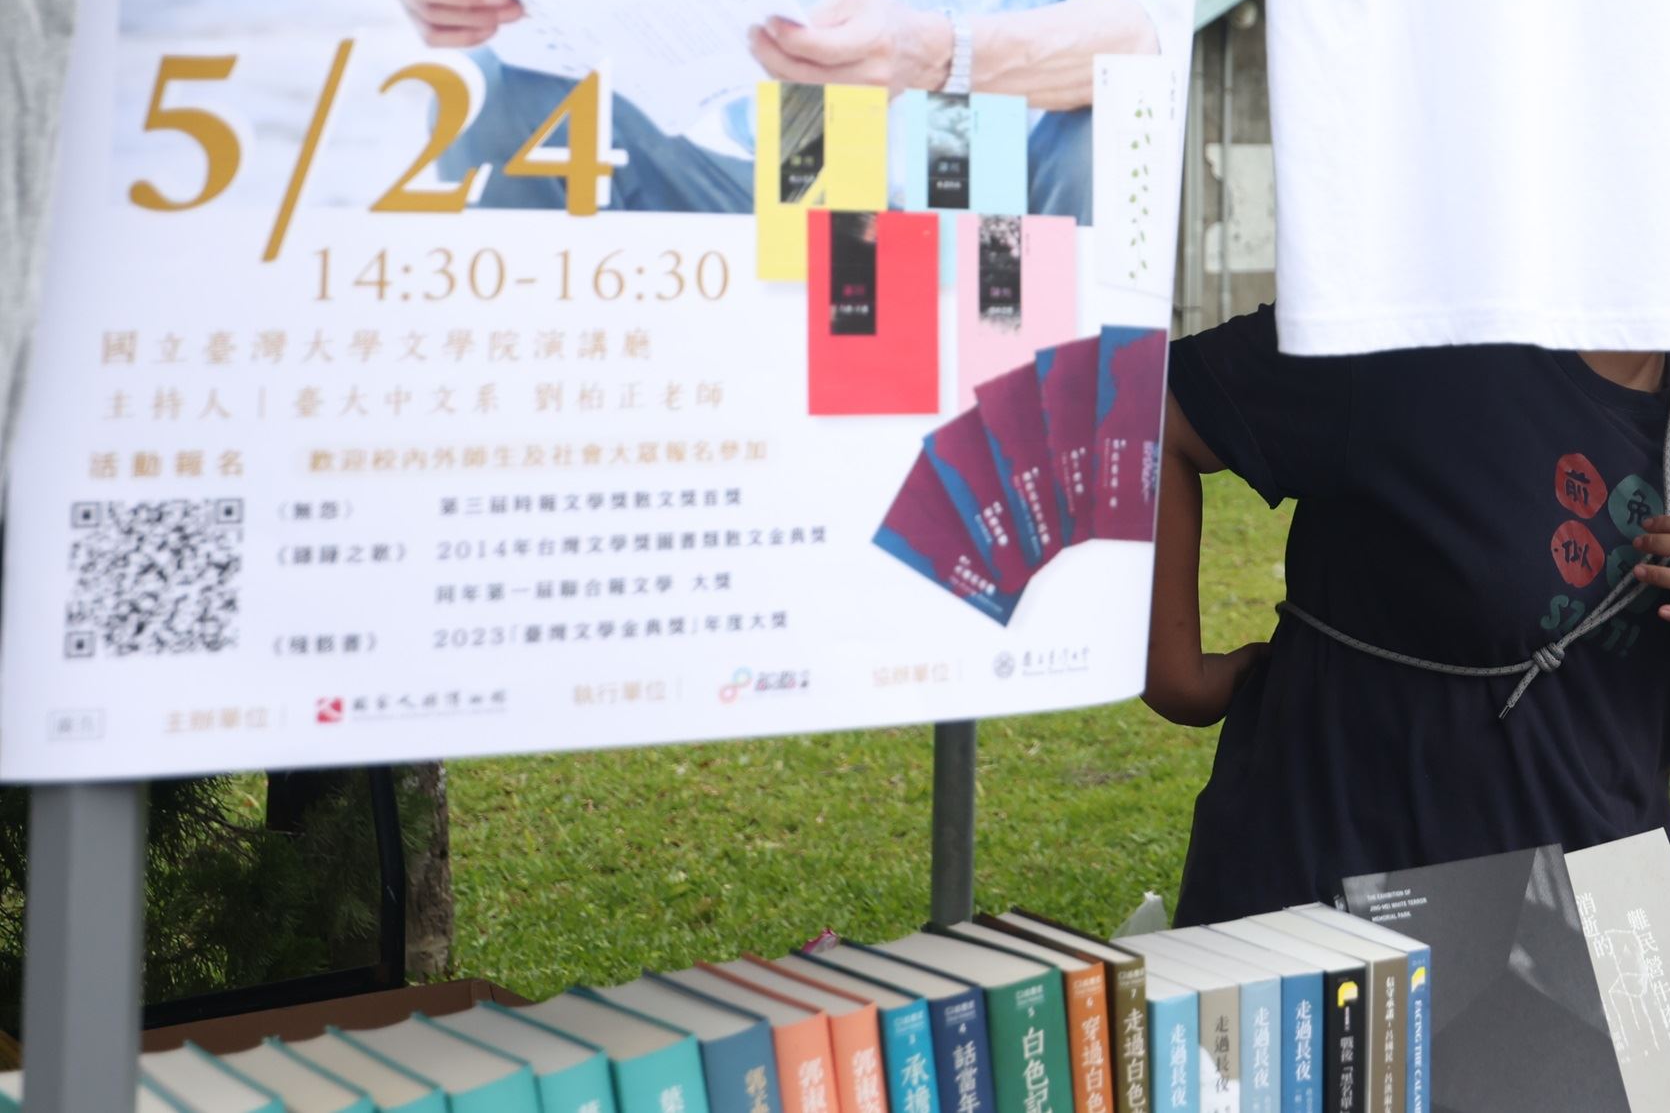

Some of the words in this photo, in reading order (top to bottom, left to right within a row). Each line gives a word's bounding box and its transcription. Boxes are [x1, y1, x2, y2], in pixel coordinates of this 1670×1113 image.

[128, 39, 622, 263] 5/24
[313, 247, 731, 304] 14:30-16:30
[1123, 1008, 1146, 1113] 走過白色
[1295, 999, 1312, 1081] 走過長夜
